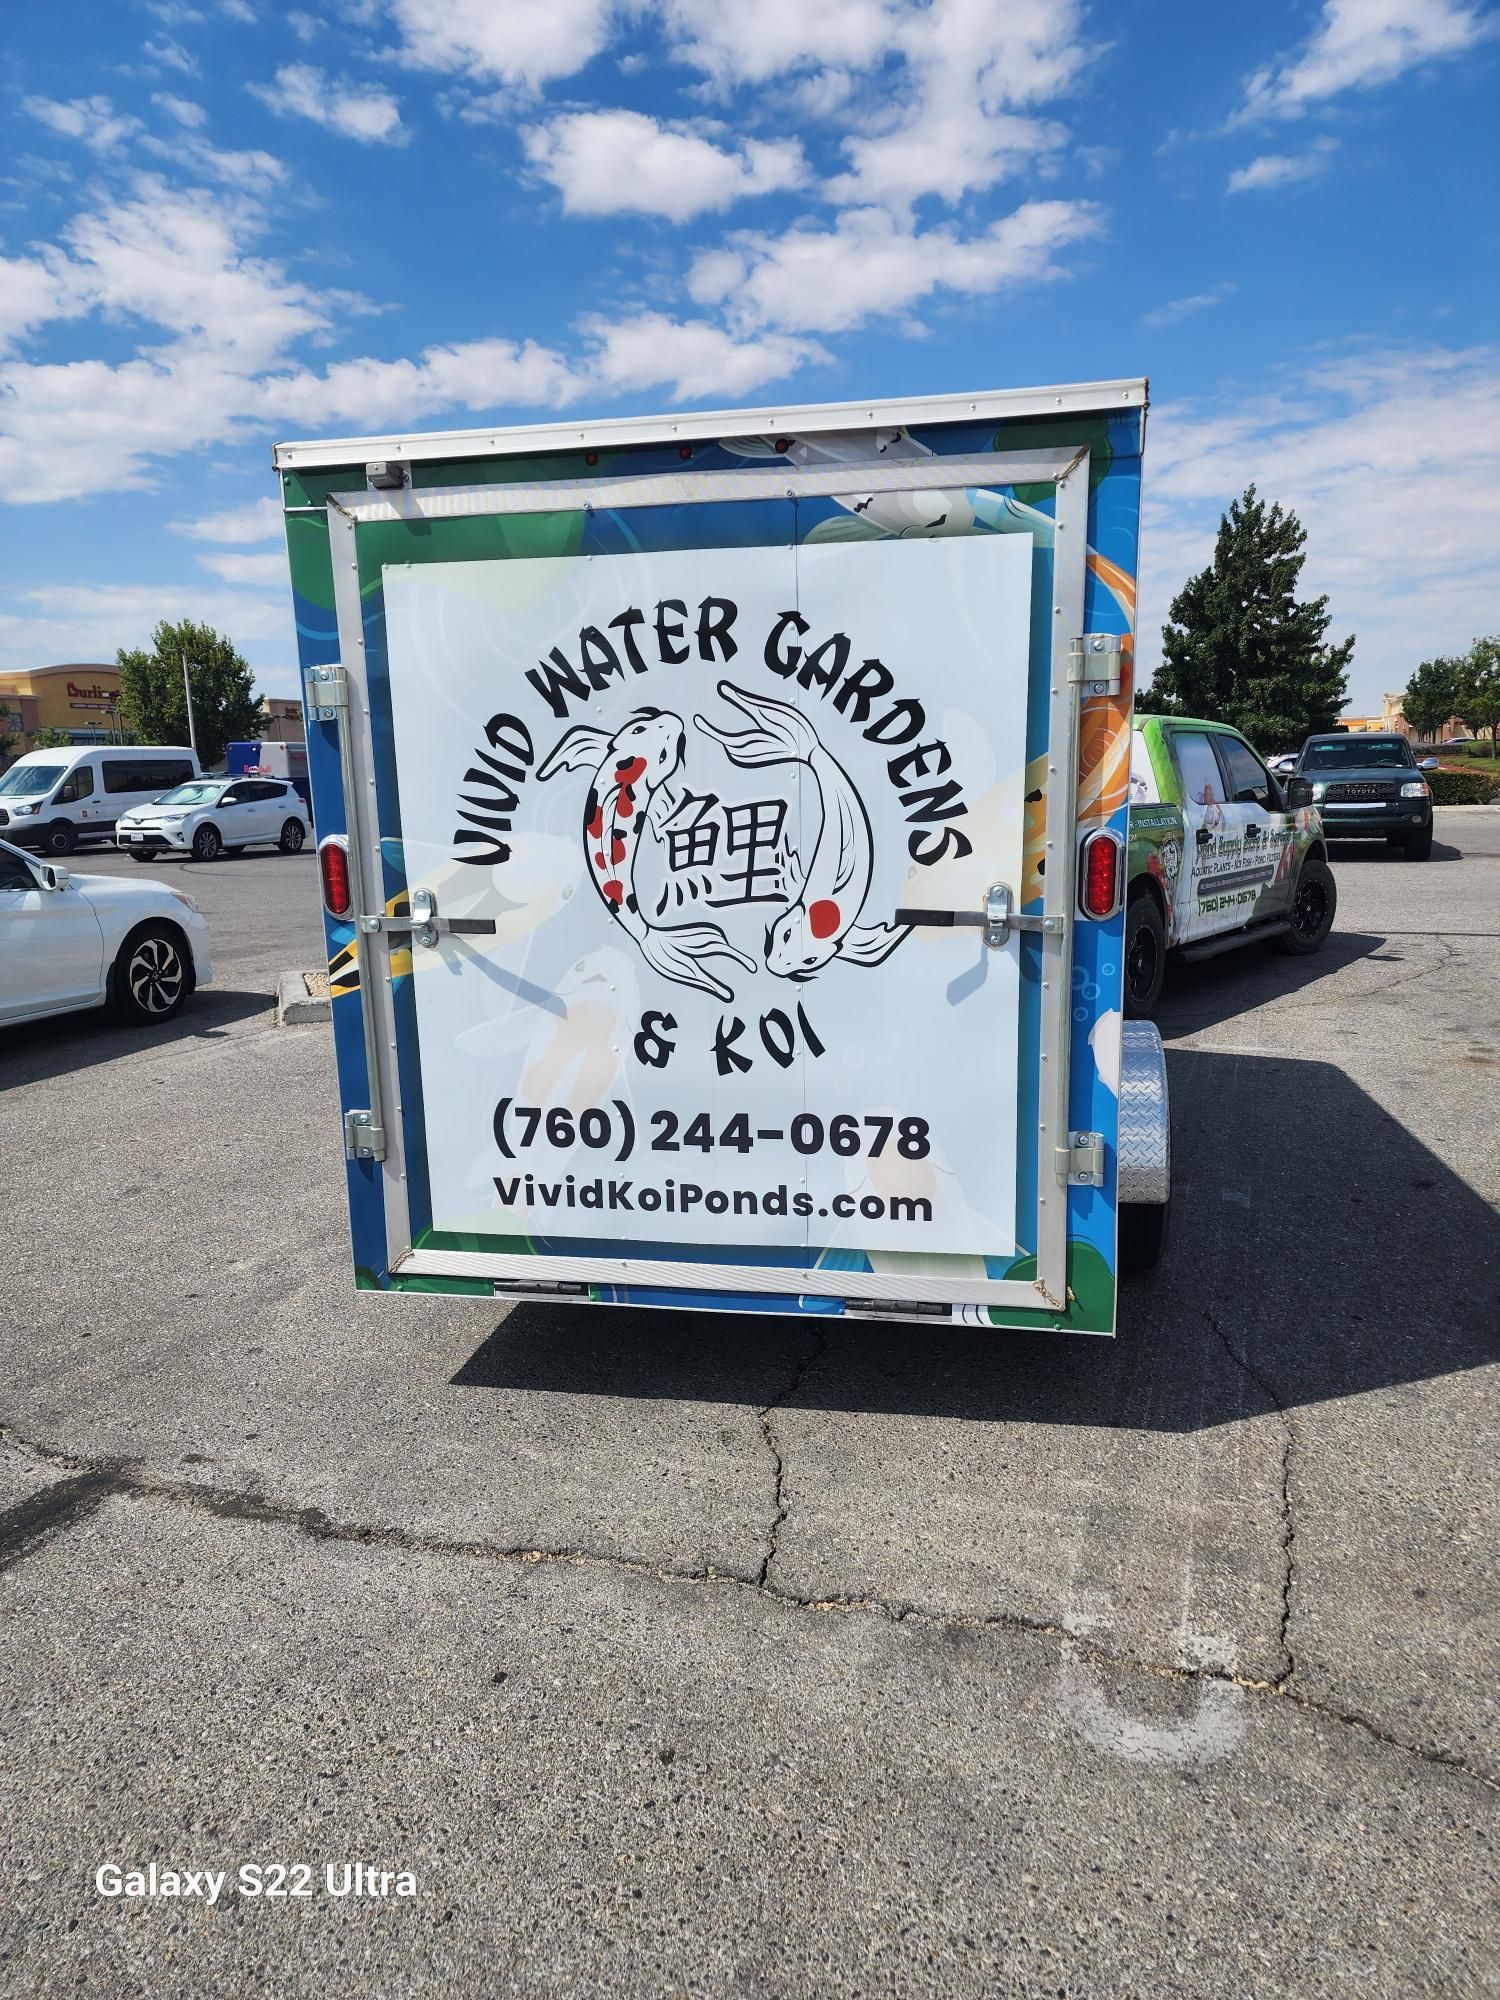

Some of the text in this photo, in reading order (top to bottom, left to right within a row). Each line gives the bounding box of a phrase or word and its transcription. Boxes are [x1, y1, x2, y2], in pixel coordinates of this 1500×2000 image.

[452, 596, 973, 867] VIVID WATER GARDENS
[656, 787, 789, 917] 鯉
[1138, 817, 1177, 828] INSTALLATION
[1198, 895, 1219, 916] (760)
[634, 1000, 826, 1077] & KOI
[493, 1097, 931, 1162] (760) 244-0678
[492, 1176, 933, 1222] VividKoiPonds.com
